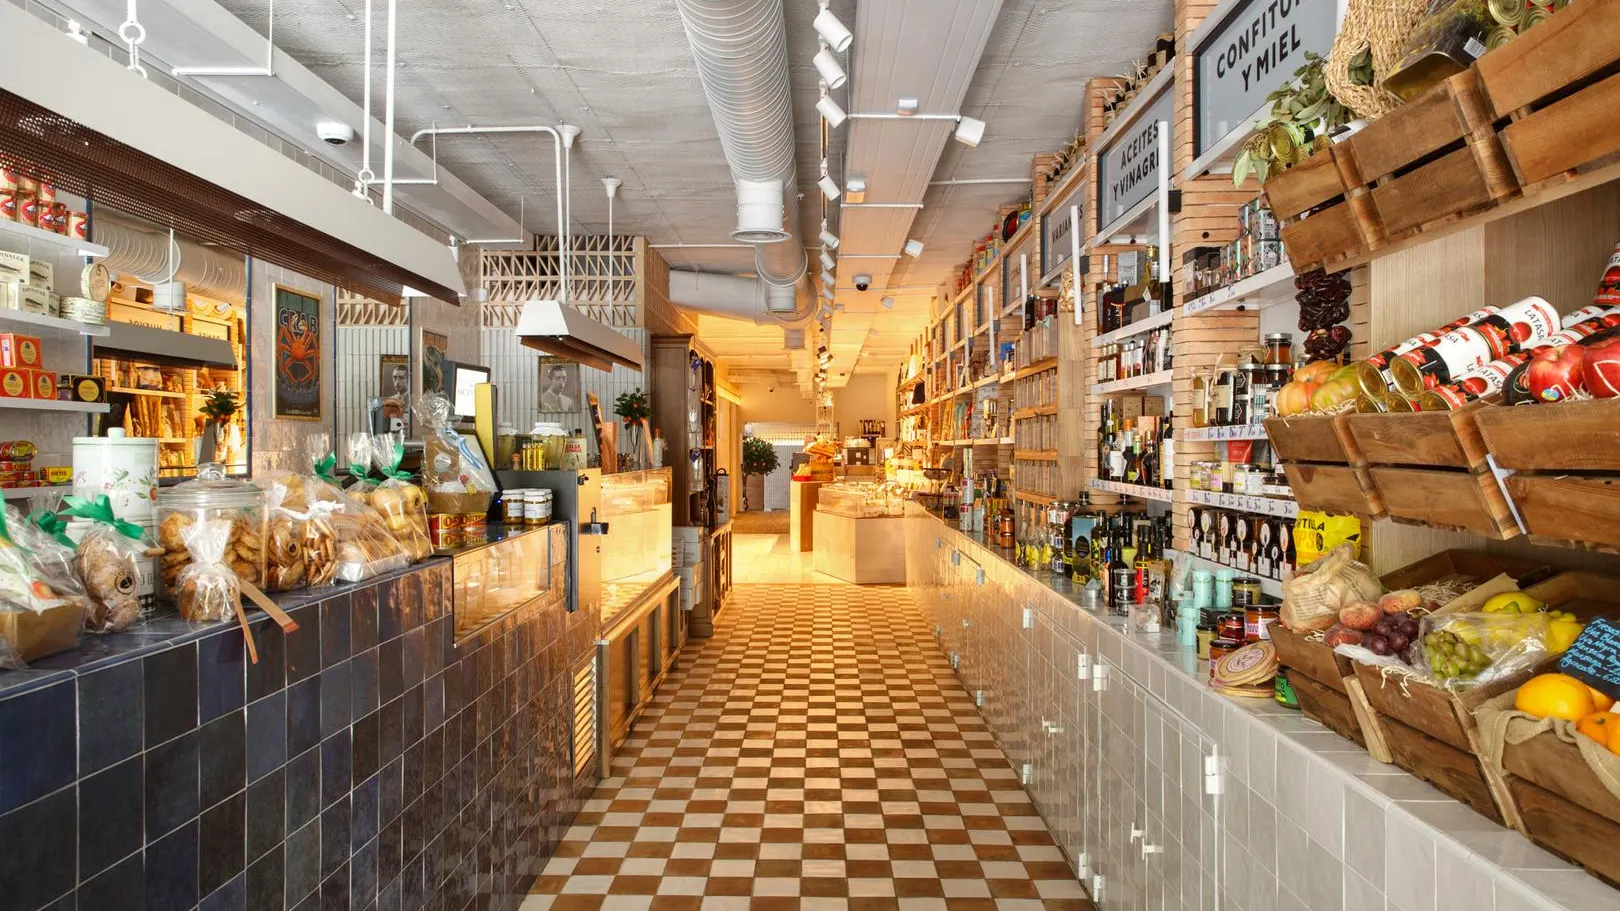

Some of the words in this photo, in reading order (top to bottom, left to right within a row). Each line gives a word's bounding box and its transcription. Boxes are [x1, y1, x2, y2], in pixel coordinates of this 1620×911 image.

[1242, 64, 1252, 91] Y
[1256, 24, 1301, 82] MIEL
[1120, 119, 1159, 170] ACEITES
[279, 307, 318, 336] CRAB
